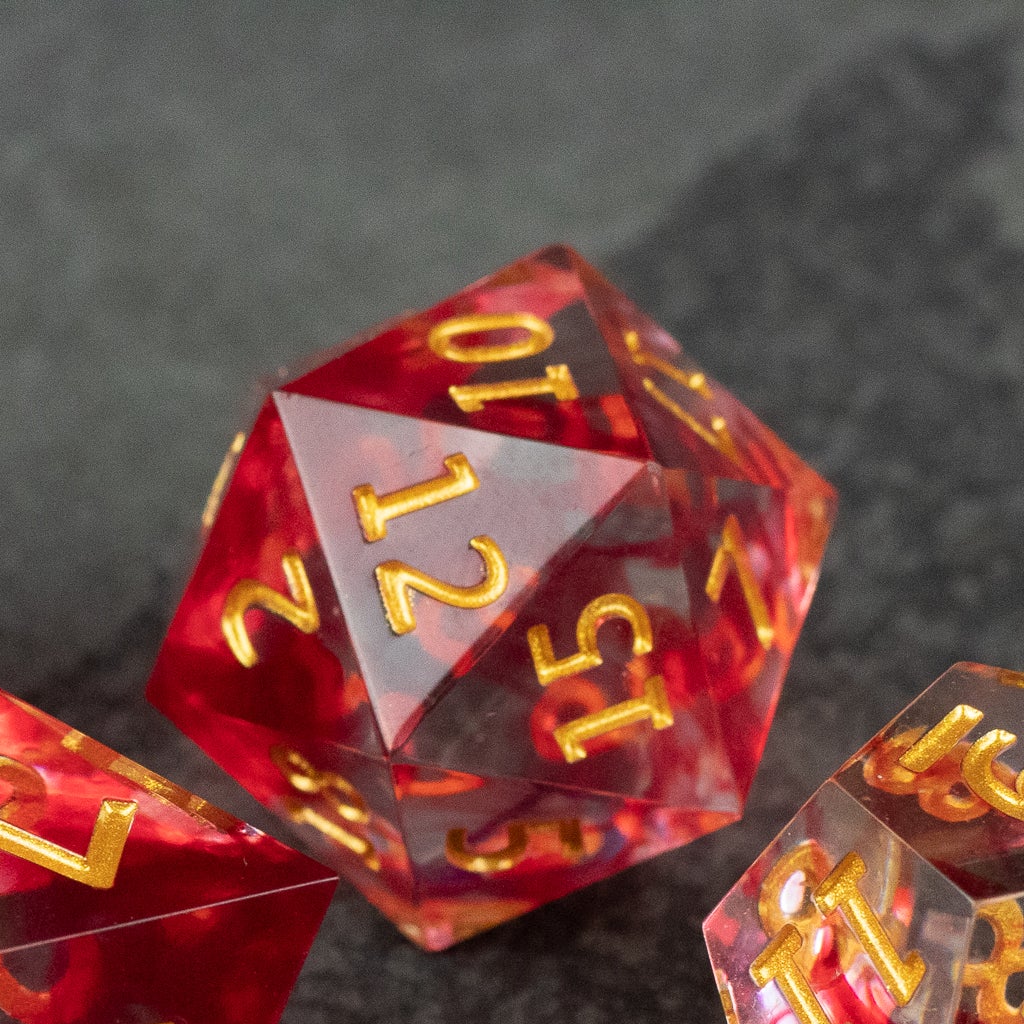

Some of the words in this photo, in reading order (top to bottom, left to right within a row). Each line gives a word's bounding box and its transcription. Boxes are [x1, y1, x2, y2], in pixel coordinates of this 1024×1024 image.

[428, 312, 581, 412] 10
[352, 453, 510, 636] 12
[526, 593, 674, 763] 15
